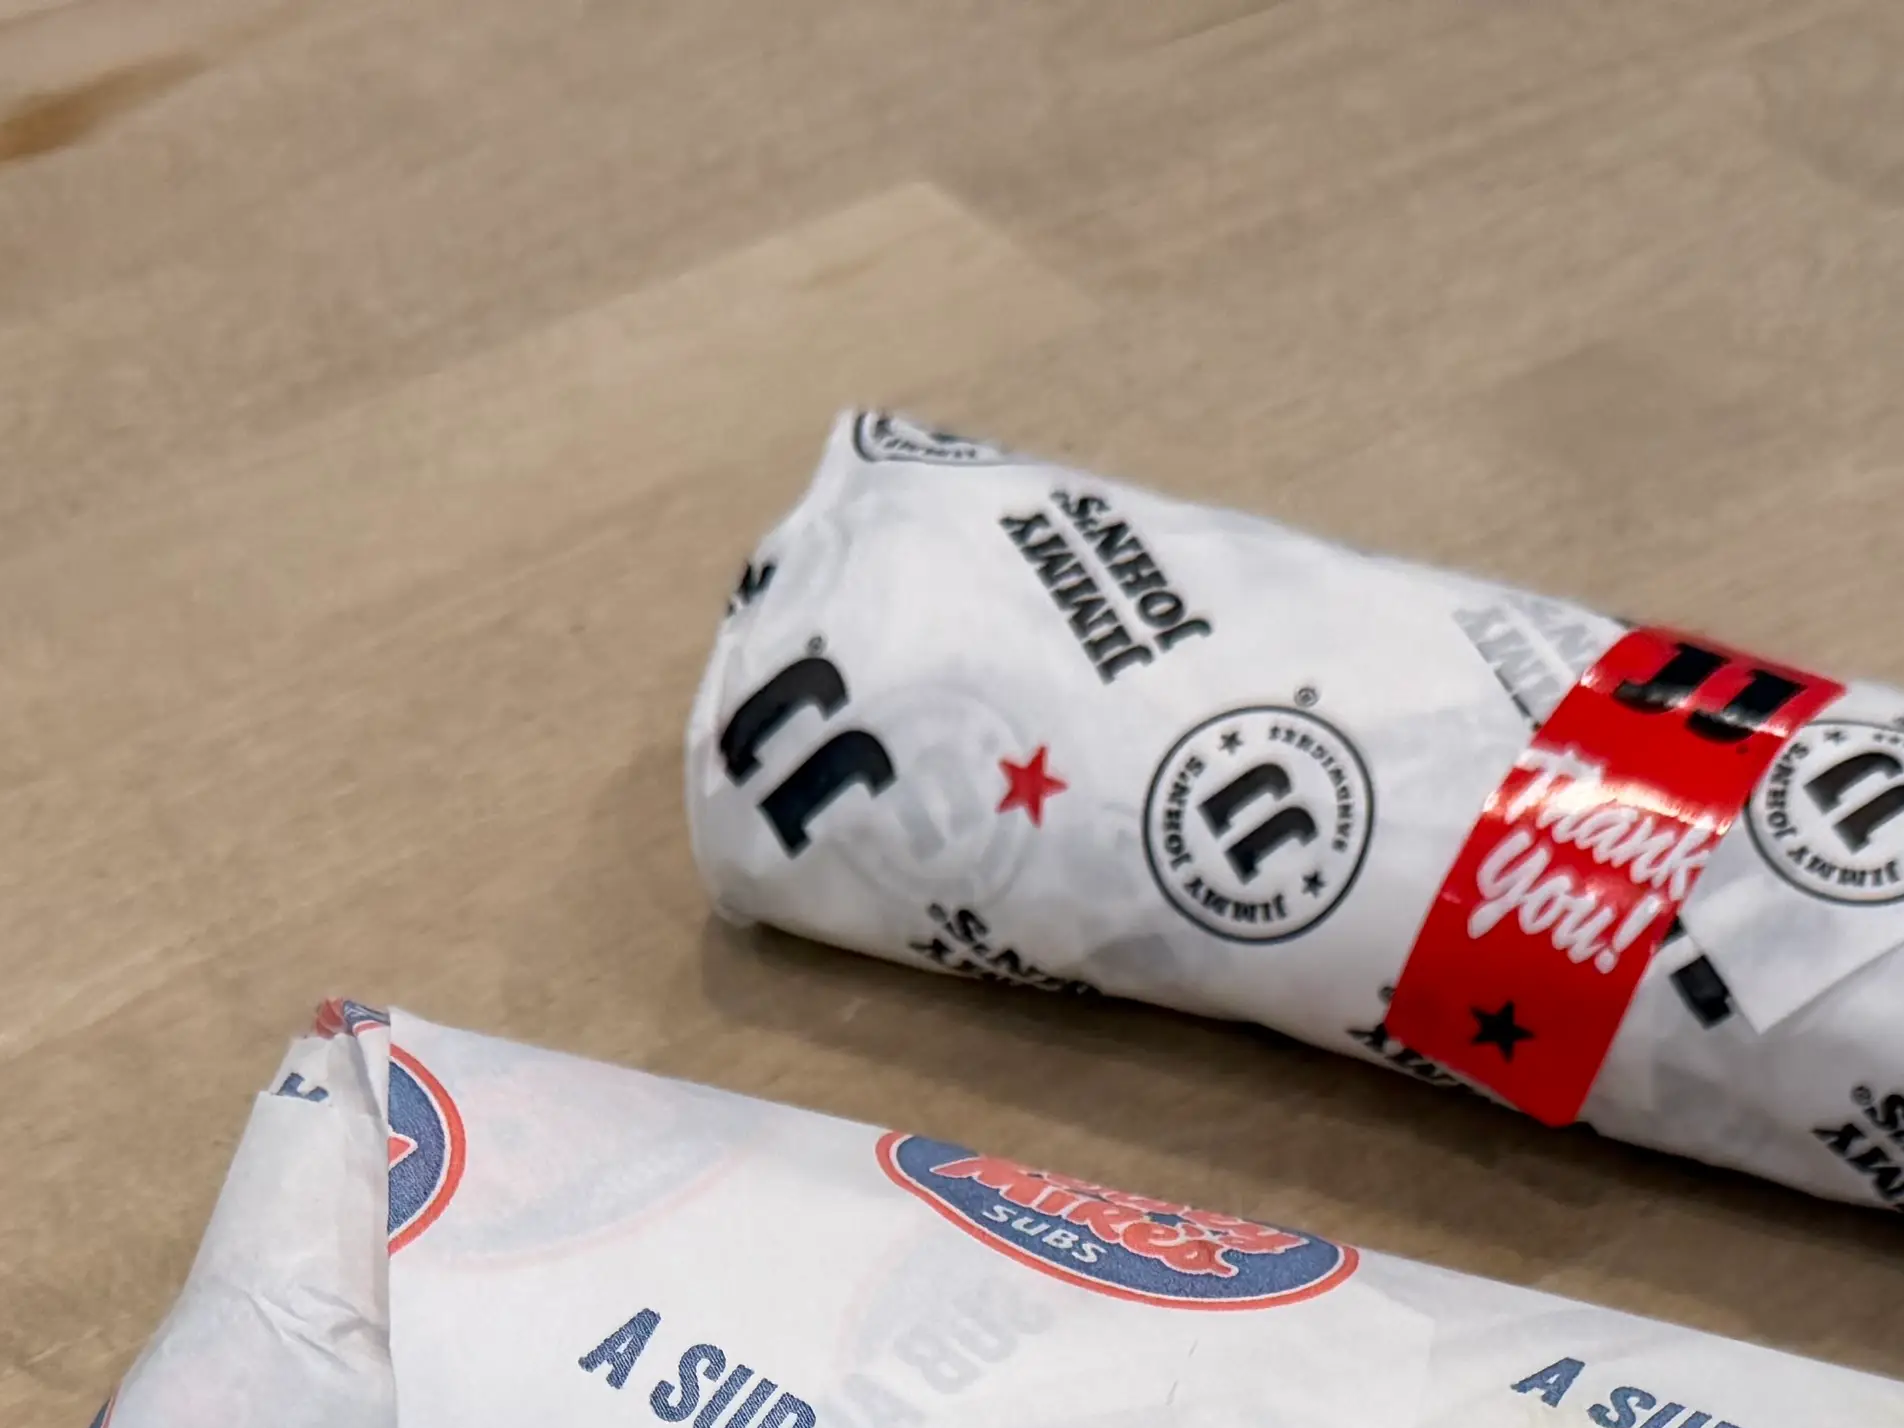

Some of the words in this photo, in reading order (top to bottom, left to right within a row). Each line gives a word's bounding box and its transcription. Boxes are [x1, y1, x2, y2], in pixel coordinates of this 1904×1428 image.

[998, 512, 1155, 686] JIMMY
[1505, 748, 1710, 900] Thank
[982, 1203, 1106, 1265] SUBS
[578, 1307, 662, 1391] A
[1510, 1357, 1588, 1408] A
